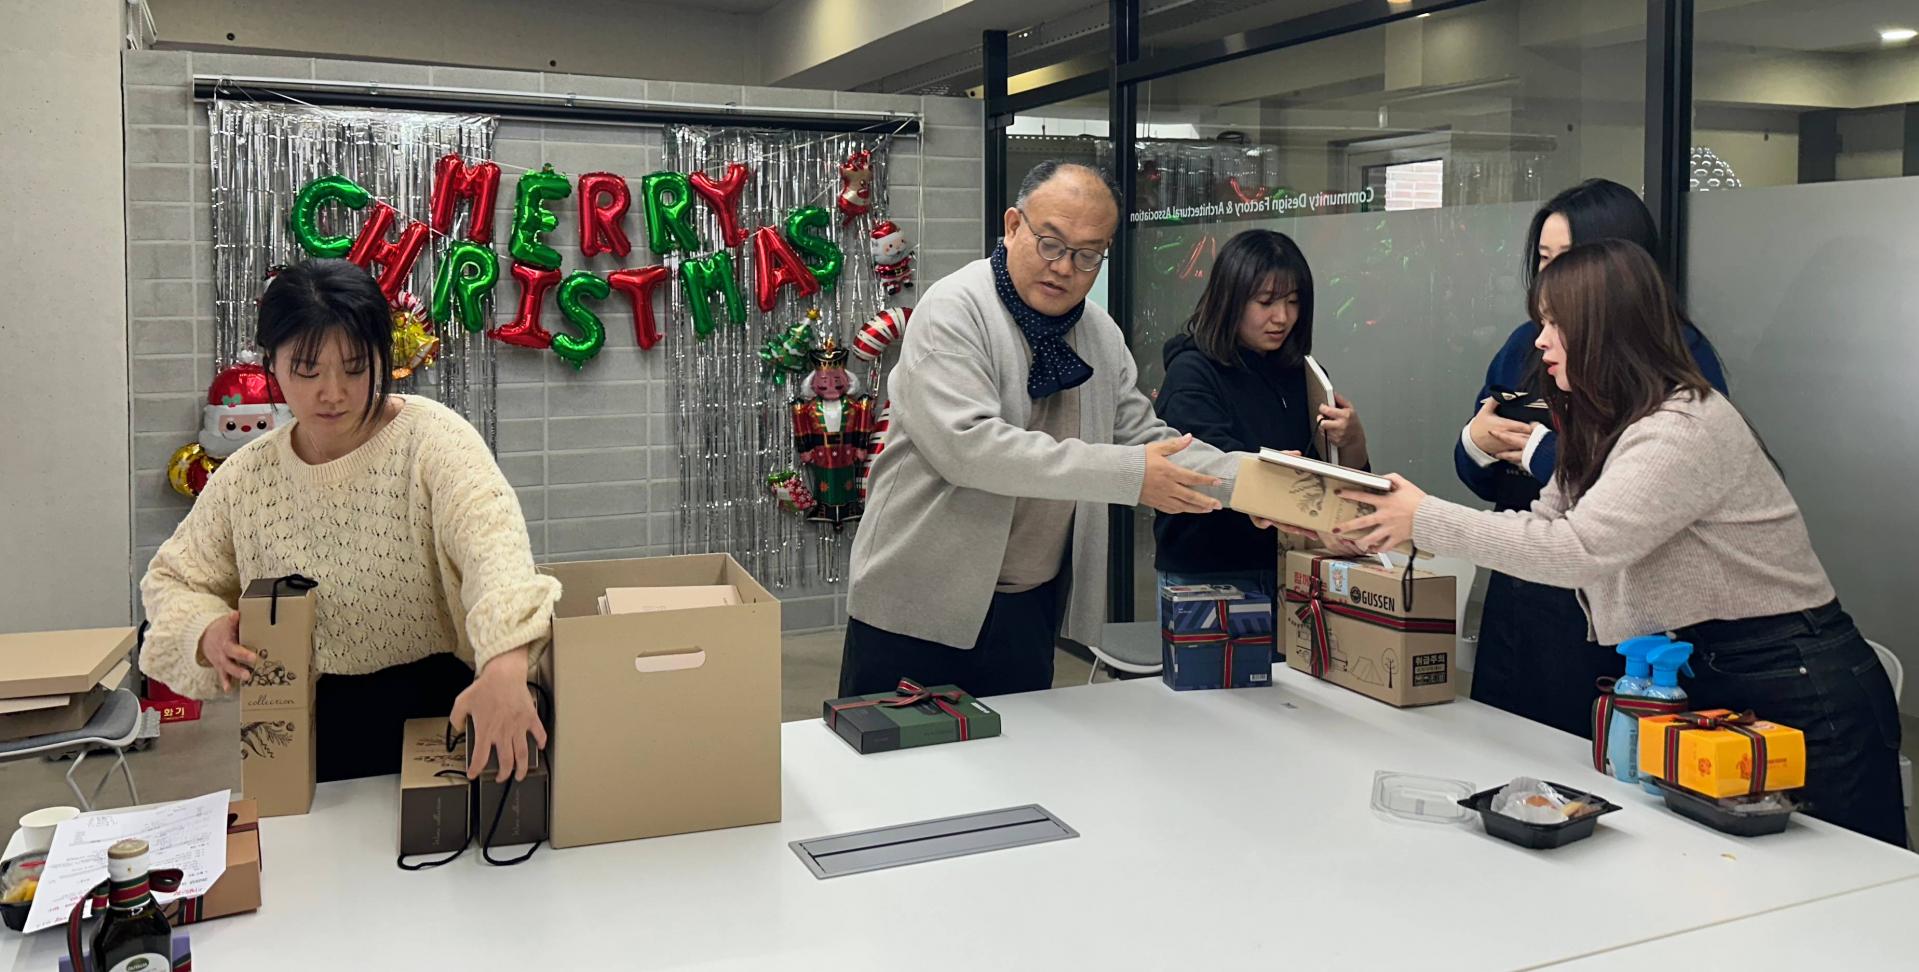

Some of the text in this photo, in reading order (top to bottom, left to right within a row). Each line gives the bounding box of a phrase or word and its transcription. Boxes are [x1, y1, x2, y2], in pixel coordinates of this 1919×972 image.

[431, 152, 749, 270] MERRY
[292, 173, 844, 372] CHRISTMAS
[1362, 590, 1395, 612] GUSSEN
[1415, 654, 1445, 666] 취급주의
[248, 694, 296, 706] collection
